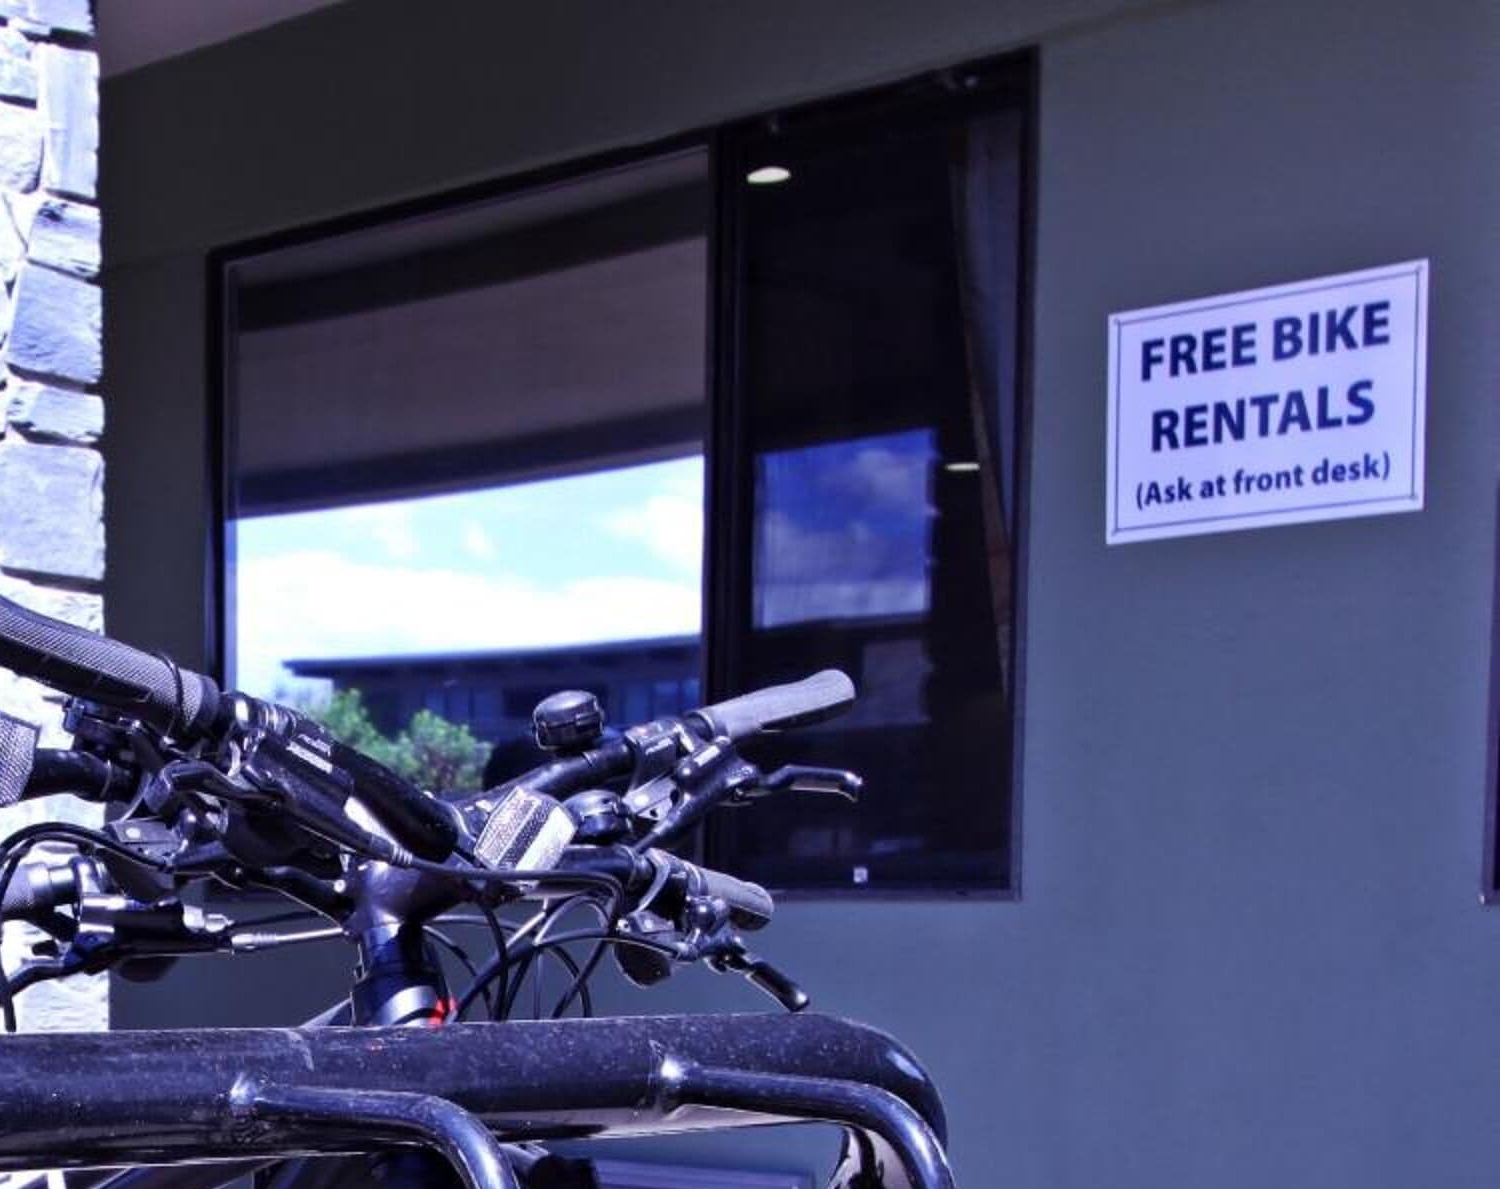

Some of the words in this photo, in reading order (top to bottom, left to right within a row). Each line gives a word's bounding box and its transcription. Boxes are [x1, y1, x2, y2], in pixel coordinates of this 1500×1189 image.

[1140, 322, 1257, 382] FREE
[1272, 301, 1391, 361] BIKE
[1150, 379, 1376, 453] RENTALS
[1136, 476, 1193, 510] (Ask
[1199, 473, 1226, 499] at
[1233, 464, 1304, 494] front
[1311, 451, 1391, 486] desk)
